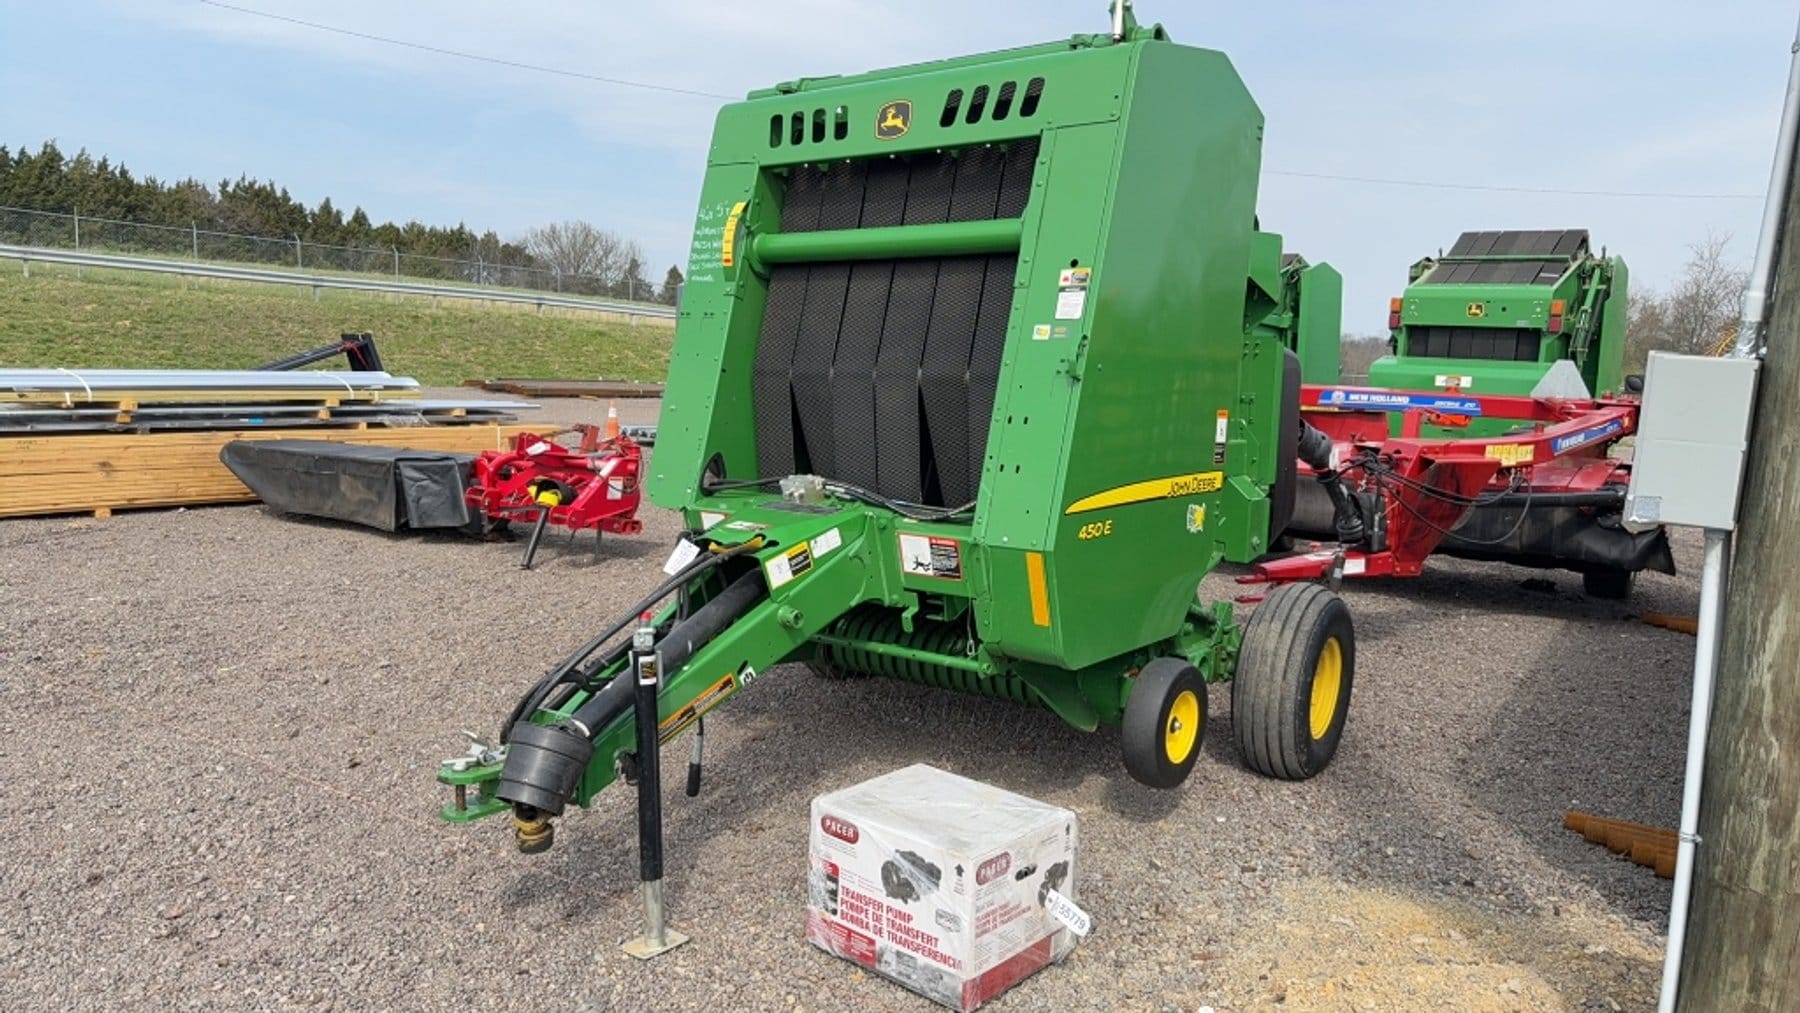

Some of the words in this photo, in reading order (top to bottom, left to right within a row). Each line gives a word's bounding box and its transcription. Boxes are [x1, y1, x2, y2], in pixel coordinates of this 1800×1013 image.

[1348, 394, 1369, 402] NEW
[1370, 395, 1410, 404] HOLLAND
[1168, 480, 1192, 496] JOHN
[1192, 476, 1217, 492] DEERE
[825, 817, 855, 839] PACER
[841, 885, 884, 914] TRANSFER
[886, 902, 914, 924] PUMP
[840, 897, 870, 919] POMPE
[872, 911, 884, 926] DE
[886, 918, 939, 948] TRANSFERT
[840, 909, 871, 932] BOMBA
[872, 924, 884, 938] DE
[887, 930, 963, 970] TRANSFERENCIA
